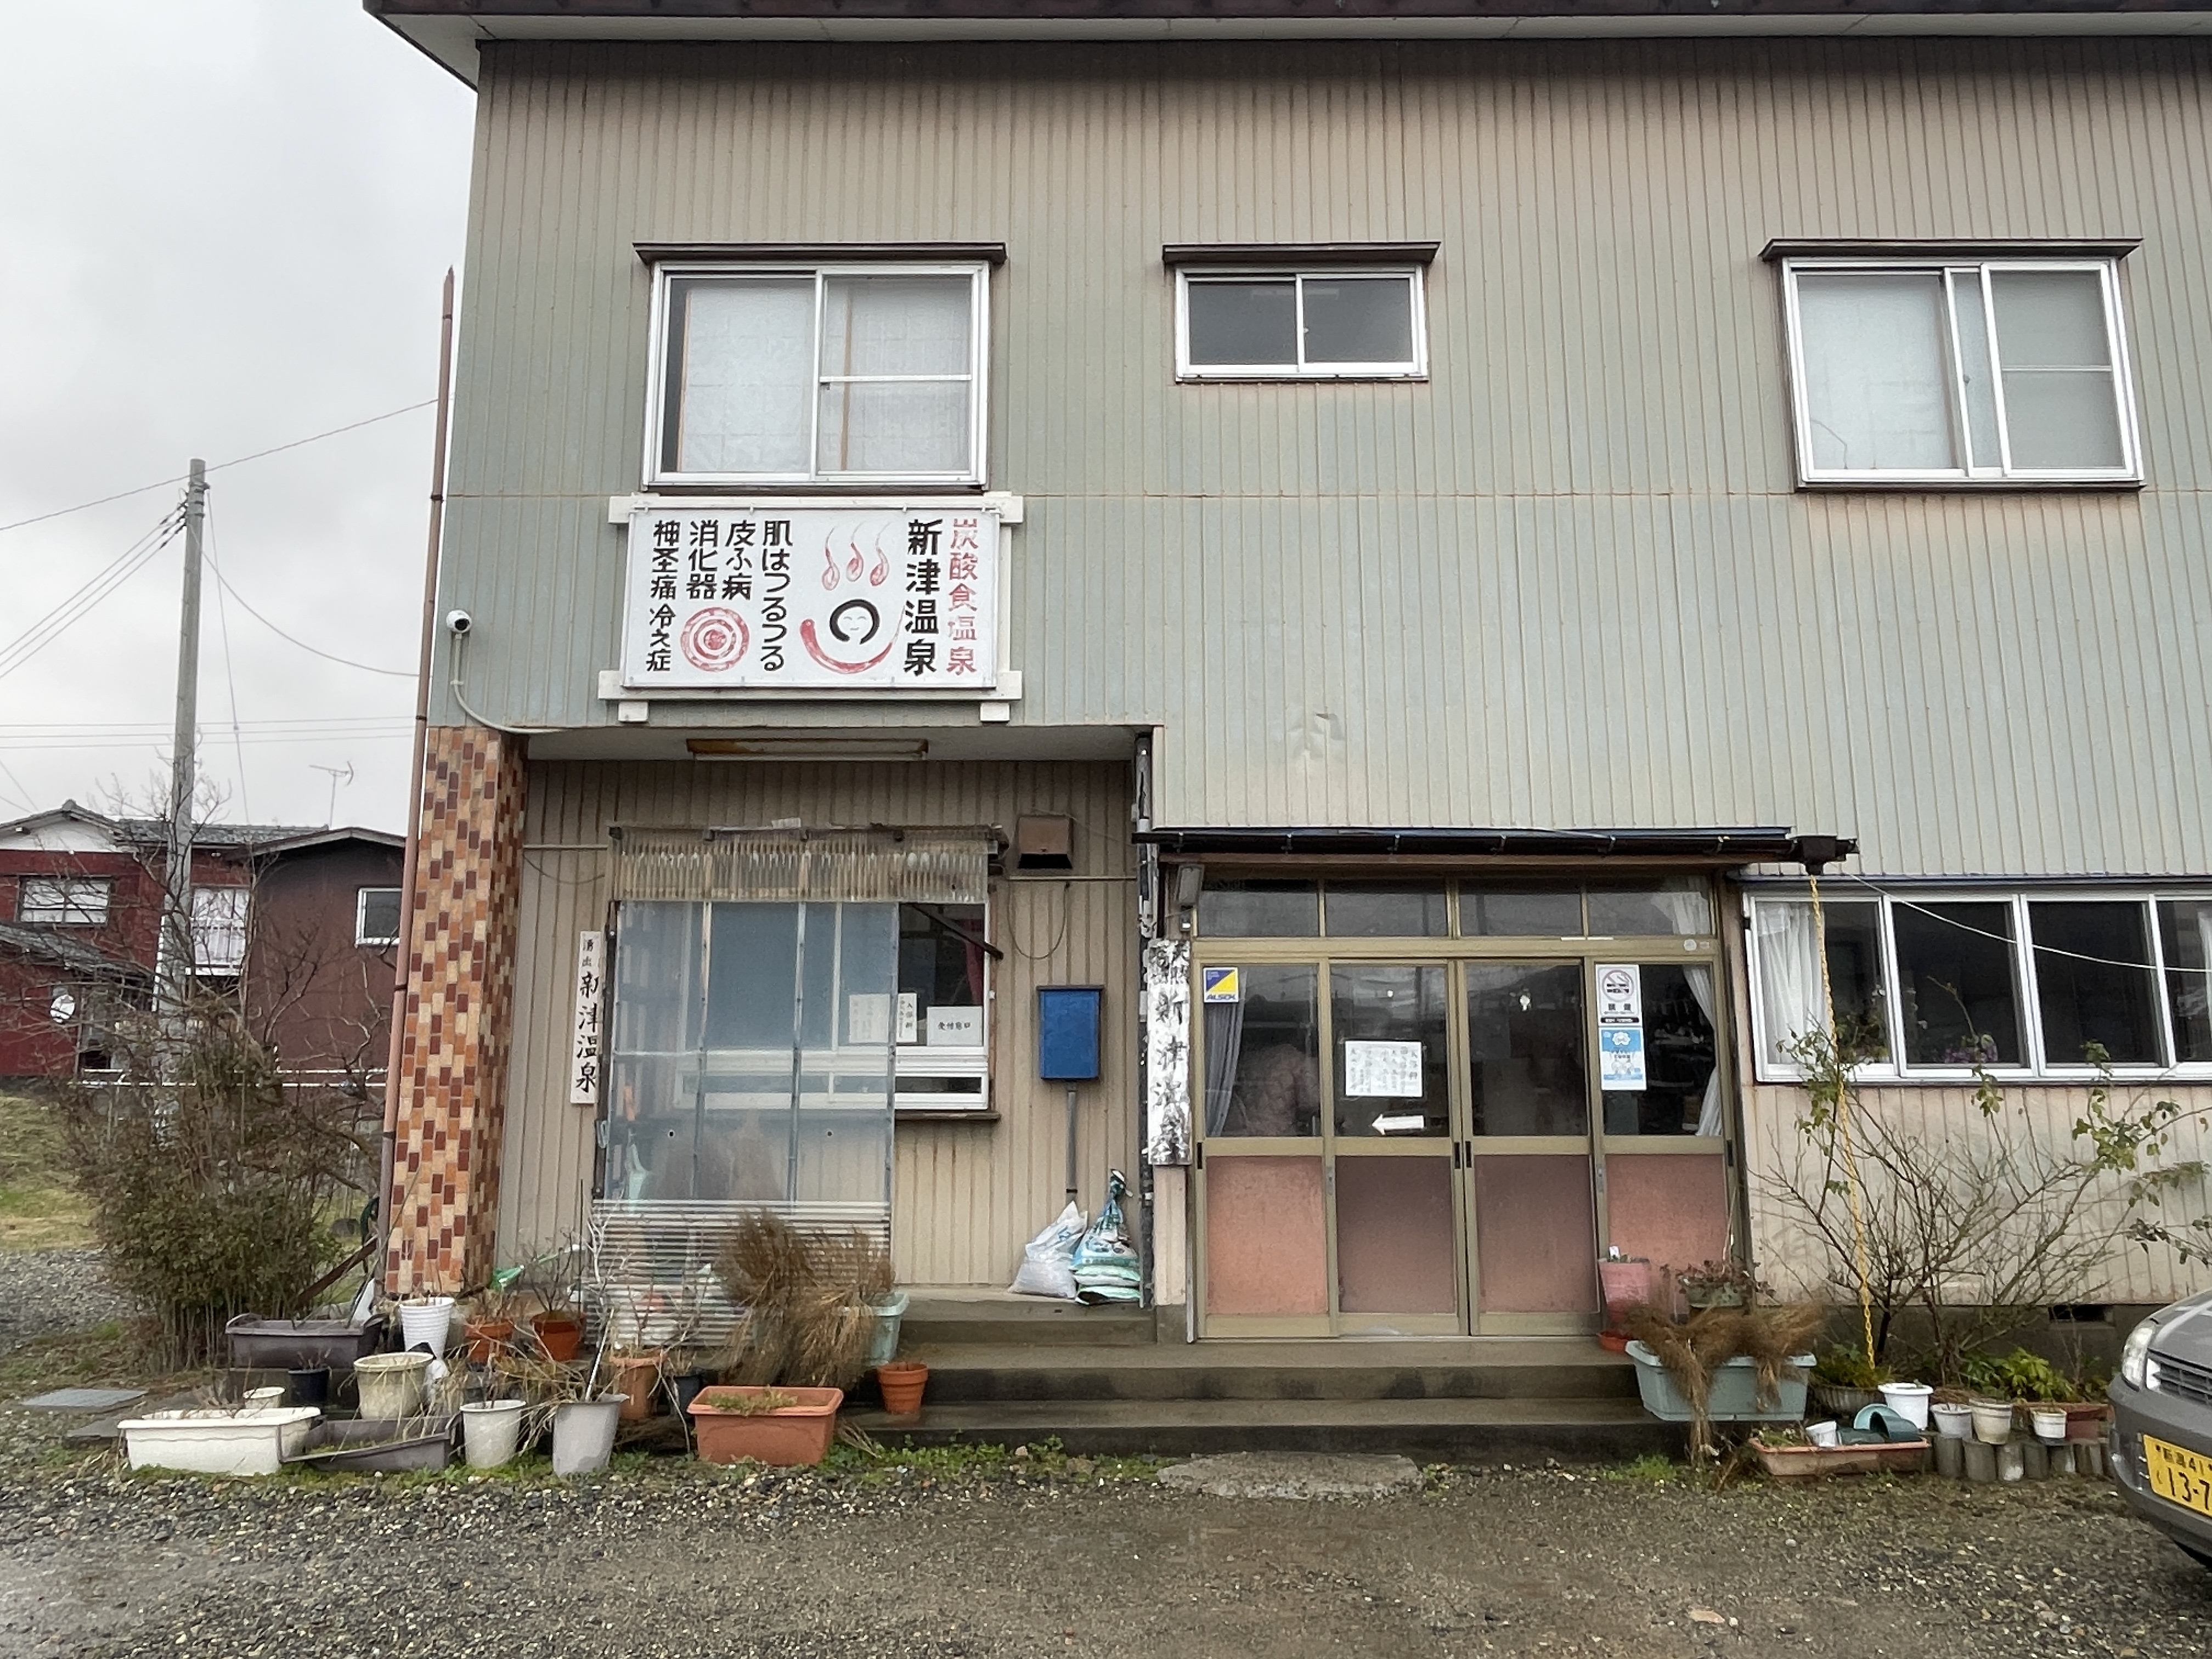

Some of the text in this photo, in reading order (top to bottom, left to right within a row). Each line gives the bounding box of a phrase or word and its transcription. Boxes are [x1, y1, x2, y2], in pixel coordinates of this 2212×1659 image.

[686, 519, 719, 600] 消化器
[721, 519, 757, 600] 皮ふ病
[760, 520, 793, 672] 肌はつるつる
[903, 518, 943, 677] 新津温泉
[575, 970, 599, 1093] 新津温泉
